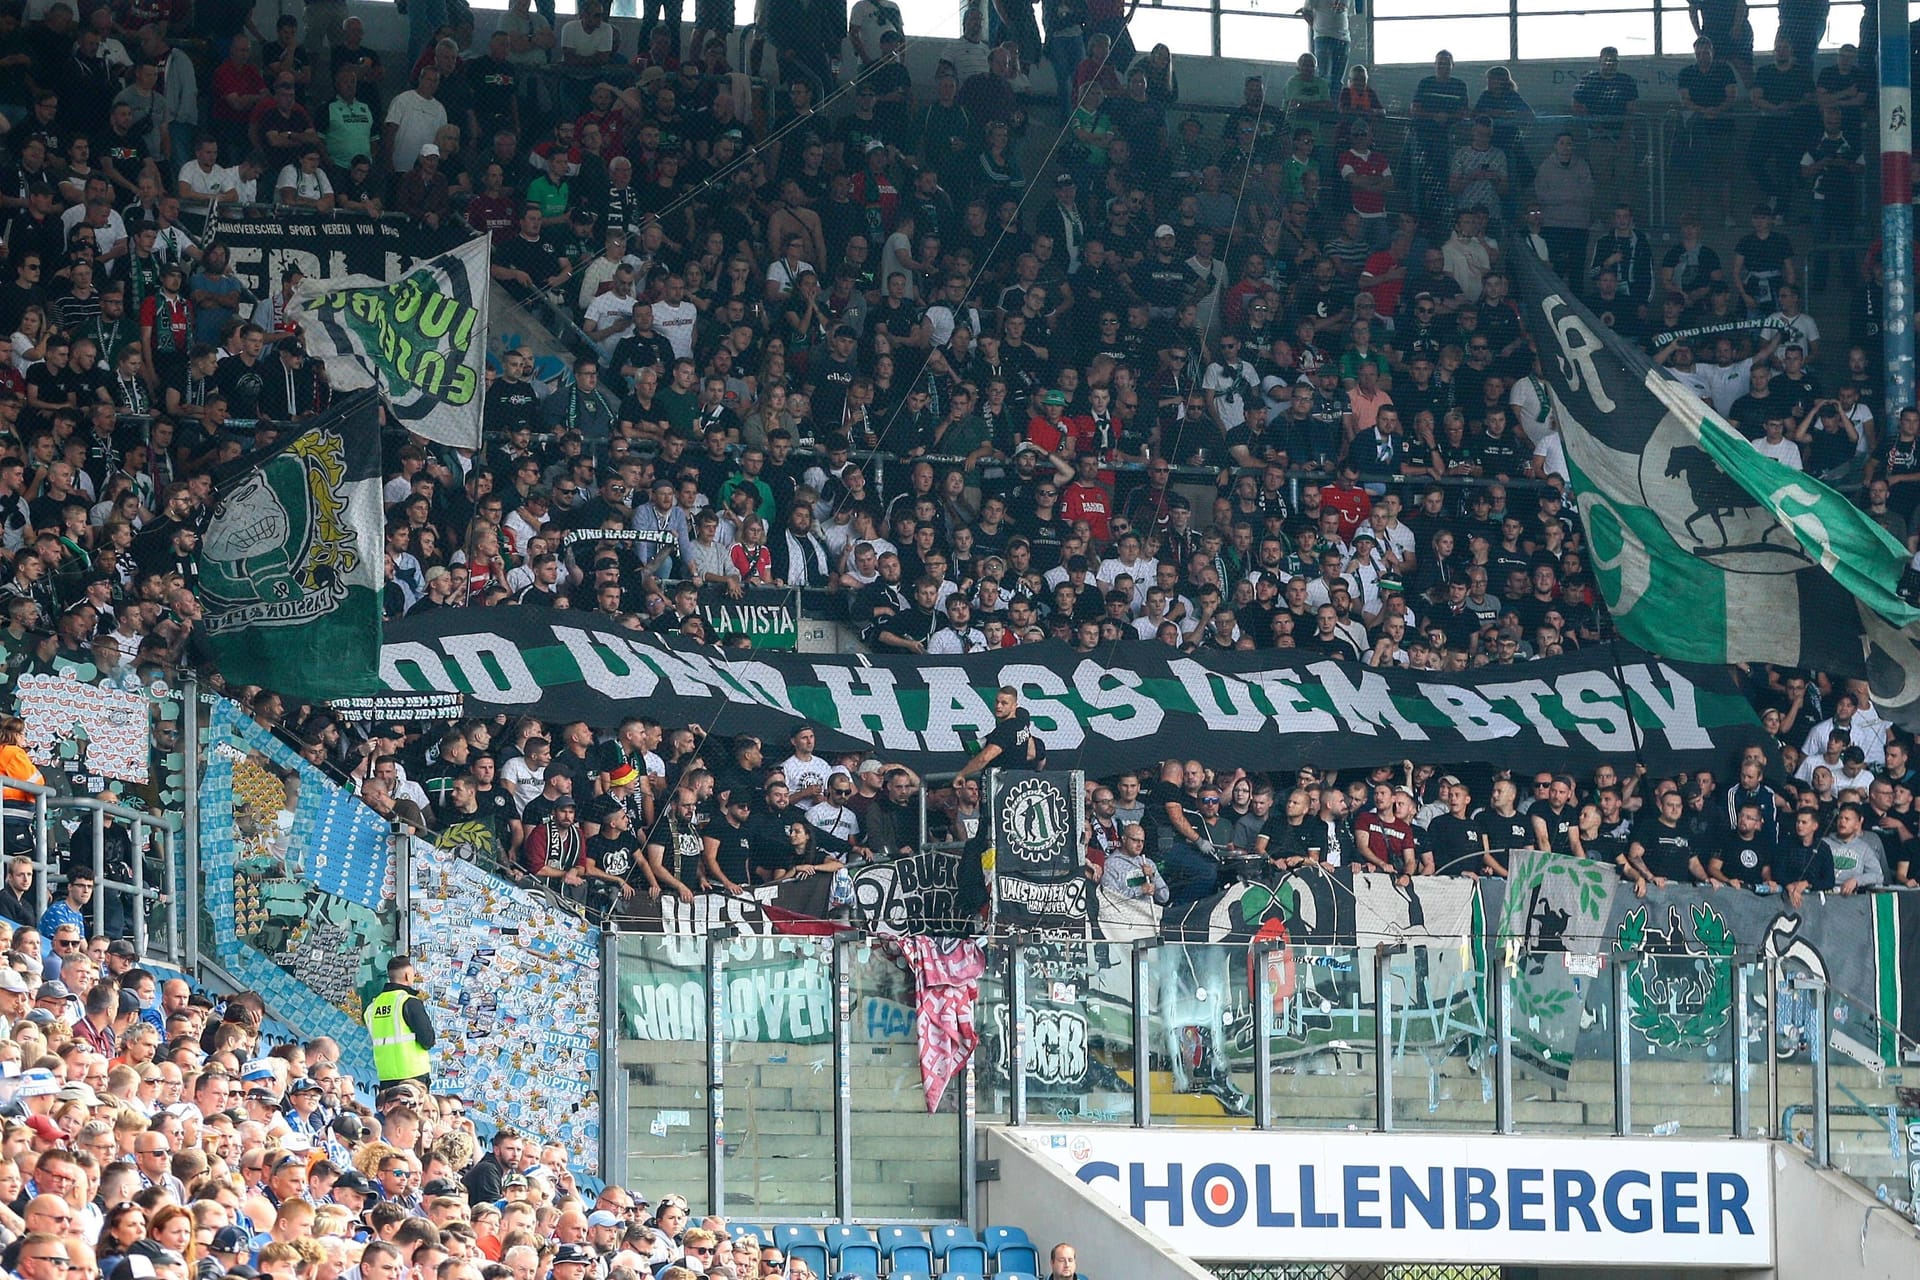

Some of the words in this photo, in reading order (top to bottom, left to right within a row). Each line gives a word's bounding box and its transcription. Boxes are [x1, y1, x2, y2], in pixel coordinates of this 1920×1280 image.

[215, 223, 283, 235] ANNOVERSCHER
[288, 224, 317, 236] SPORT
[321, 223, 351, 235] VEREIN
[356, 224, 374, 235] VON
[563, 531, 578, 547] OD
[577, 528, 602, 541] UND
[735, 605, 795, 635] VISTA
[379, 631, 544, 705] OD
[550, 624, 806, 720] UND
[811, 661, 1165, 753] HASS
[1166, 657, 1430, 742] DEM
[1416, 661, 1716, 753] BTSV
[484, 874, 514, 896] SUPT
[375, 1005, 392, 1016] ABS
[542, 1031, 590, 1049] SUPTRA
